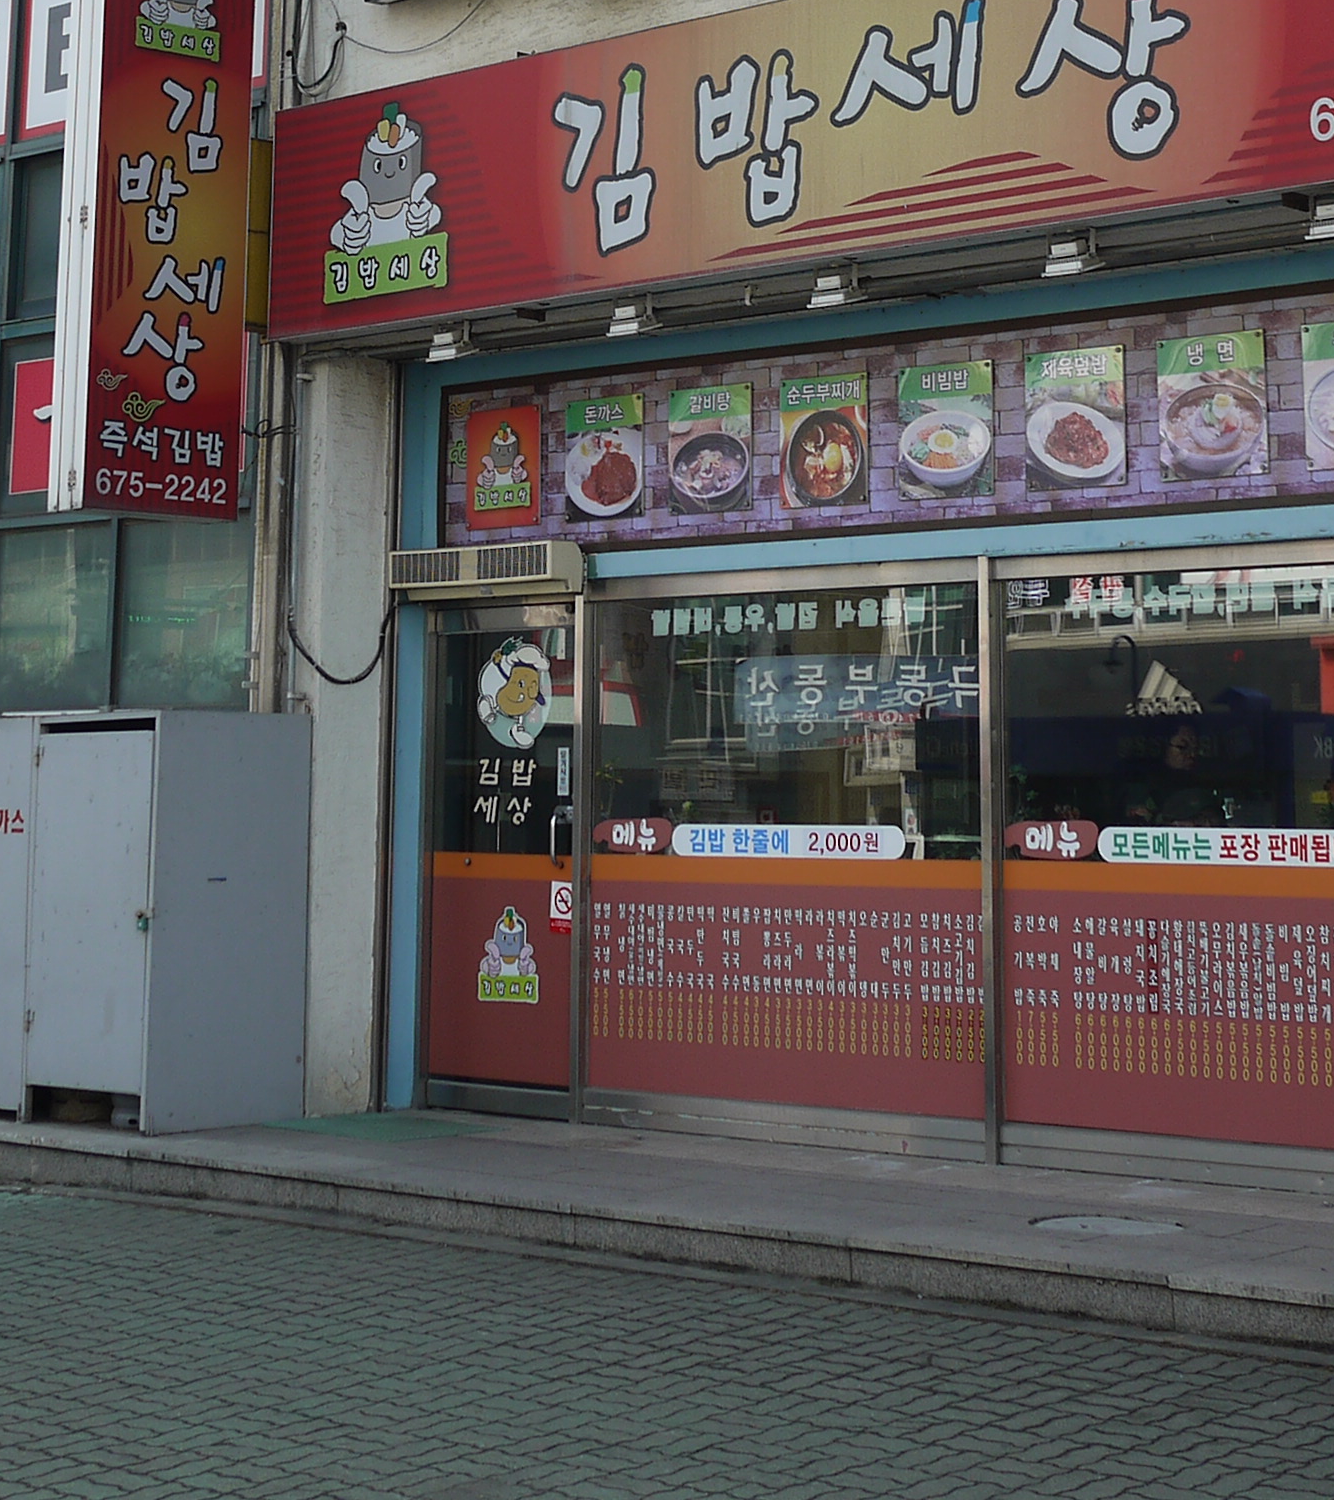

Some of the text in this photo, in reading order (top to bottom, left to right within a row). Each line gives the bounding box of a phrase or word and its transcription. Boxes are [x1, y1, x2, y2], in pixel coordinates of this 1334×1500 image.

[139, 24, 218, 61] 김밥세상
[116, 77, 227, 403] 김밥세상
[329, 244, 443, 294] 김밥세상
[1039, 355, 1108, 380] 제육덮밥
[1185, 340, 1236, 367] 냉면
[785, 378, 863, 407] 순두부찌개
[919, 367, 970, 393] 비빔밥
[583, 402, 625, 426] 돈까스
[687, 390, 731, 413] 갈비탕
[99, 418, 225, 469] 즉석김밥
[94, 466, 229, 506] 675-2242
[477, 756, 537, 788] 김밥
[473, 794, 533, 826] 세상
[610, 817, 881, 856] 메뉴 김밥 한줄에 2,000원
[1024, 820, 1082, 858] 메뉴
[1110, 832, 1213, 862] 모든메뉴는
[1218, 832, 1261, 861] 포장
